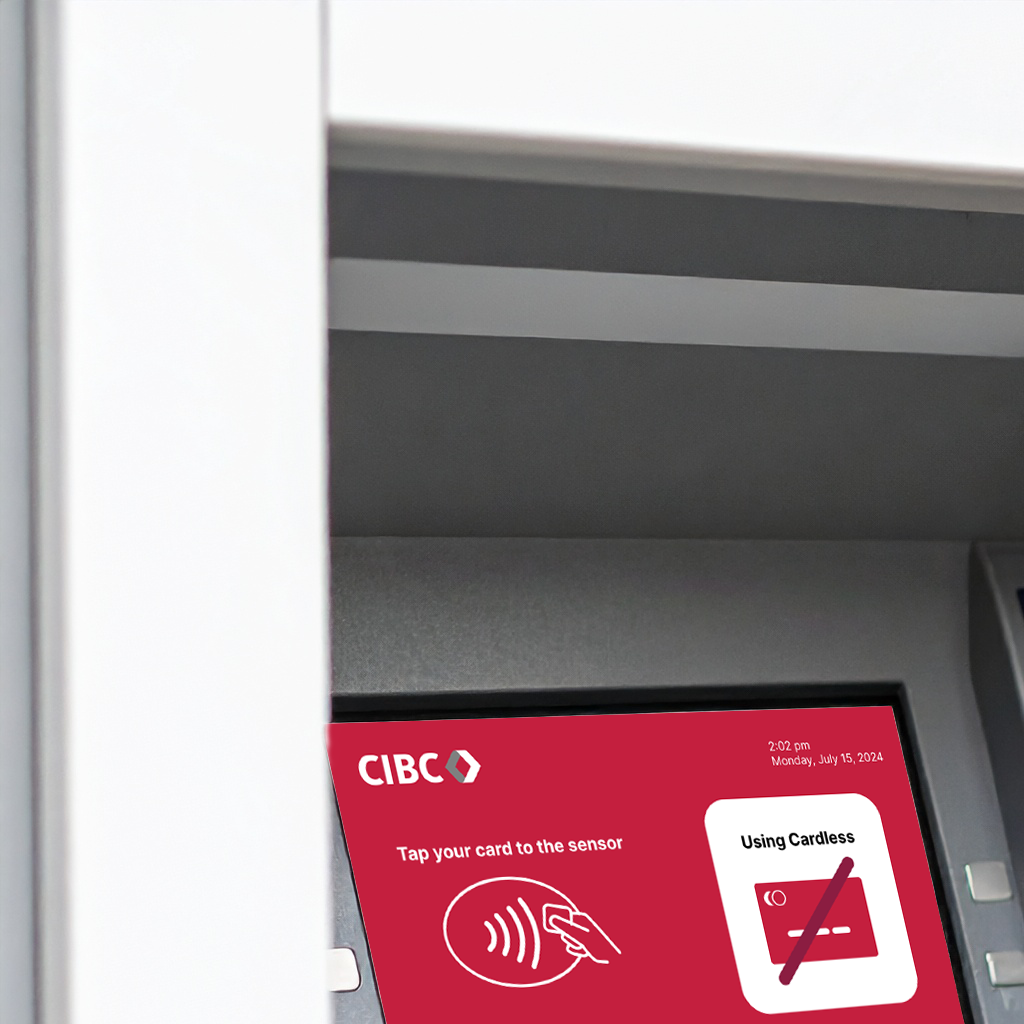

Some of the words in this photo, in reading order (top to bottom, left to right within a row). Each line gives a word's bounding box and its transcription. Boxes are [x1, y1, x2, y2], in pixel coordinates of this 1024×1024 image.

[767, 740, 792, 752] 2:02
[793, 741, 811, 753] pm
[357, 752, 445, 786] CIBC
[771, 755, 816, 767] Monday,
[818, 754, 838, 767] July
[840, 752, 856, 765] 15,
[857, 751, 884, 763] 2024
[396, 846, 430, 864] Tap
[432, 845, 472, 864] your
[475, 840, 513, 858] card
[515, 841, 534, 855] to
[535, 838, 565, 854] the
[567, 838, 624, 853] sensor
[740, 833, 787, 851] Using
[788, 830, 856, 847] Cardless
